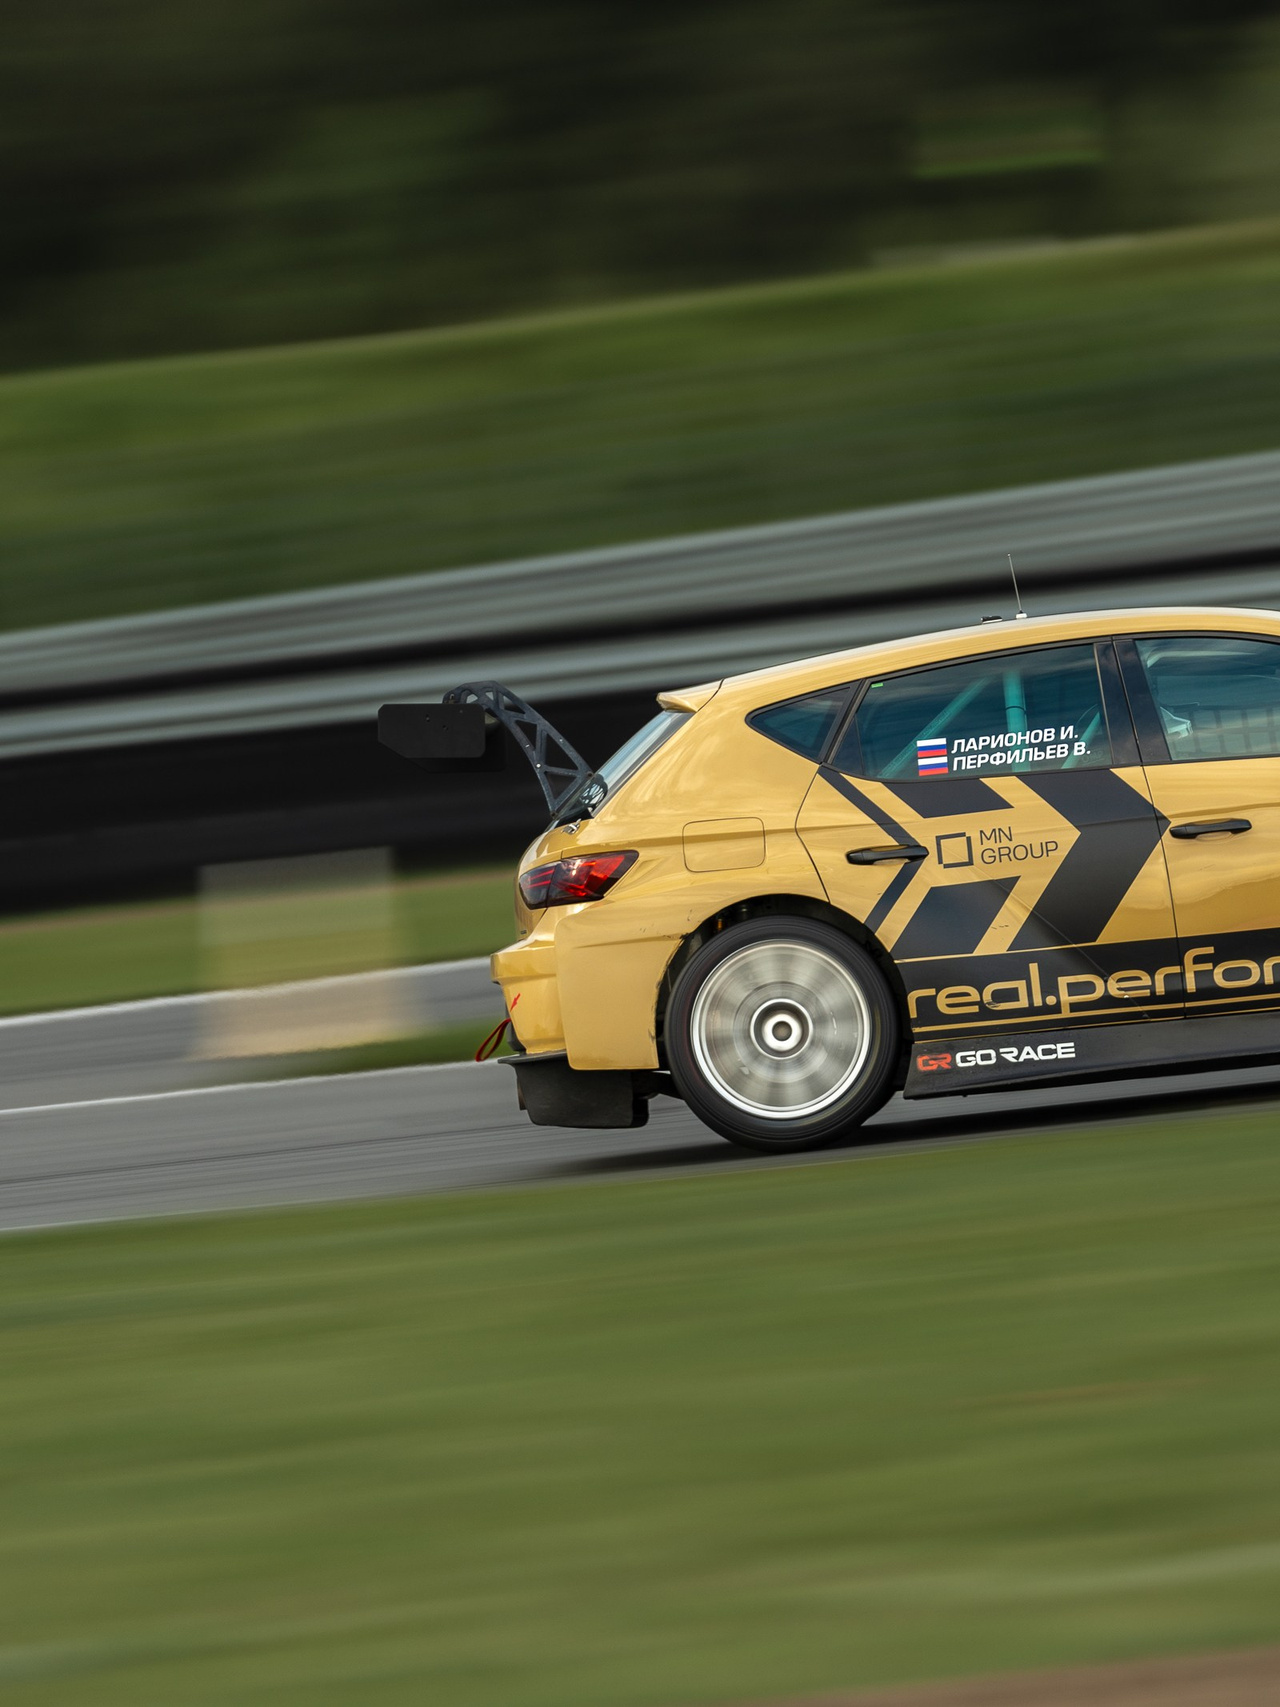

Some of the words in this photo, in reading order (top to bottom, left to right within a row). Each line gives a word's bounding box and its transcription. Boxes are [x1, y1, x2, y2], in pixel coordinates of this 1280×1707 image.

[951, 728, 1055, 754] ЛАРИОНОВ
[1060, 725, 1079, 740] И.
[953, 744, 1069, 771] ПЕРФИЛЬЕВ
[1073, 741, 1091, 756] В.
[979, 826, 1013, 845] MN
[981, 840, 1058, 865] GROUP
[955, 1048, 997, 1068] GO
[999, 1042, 1076, 1063] RACE
